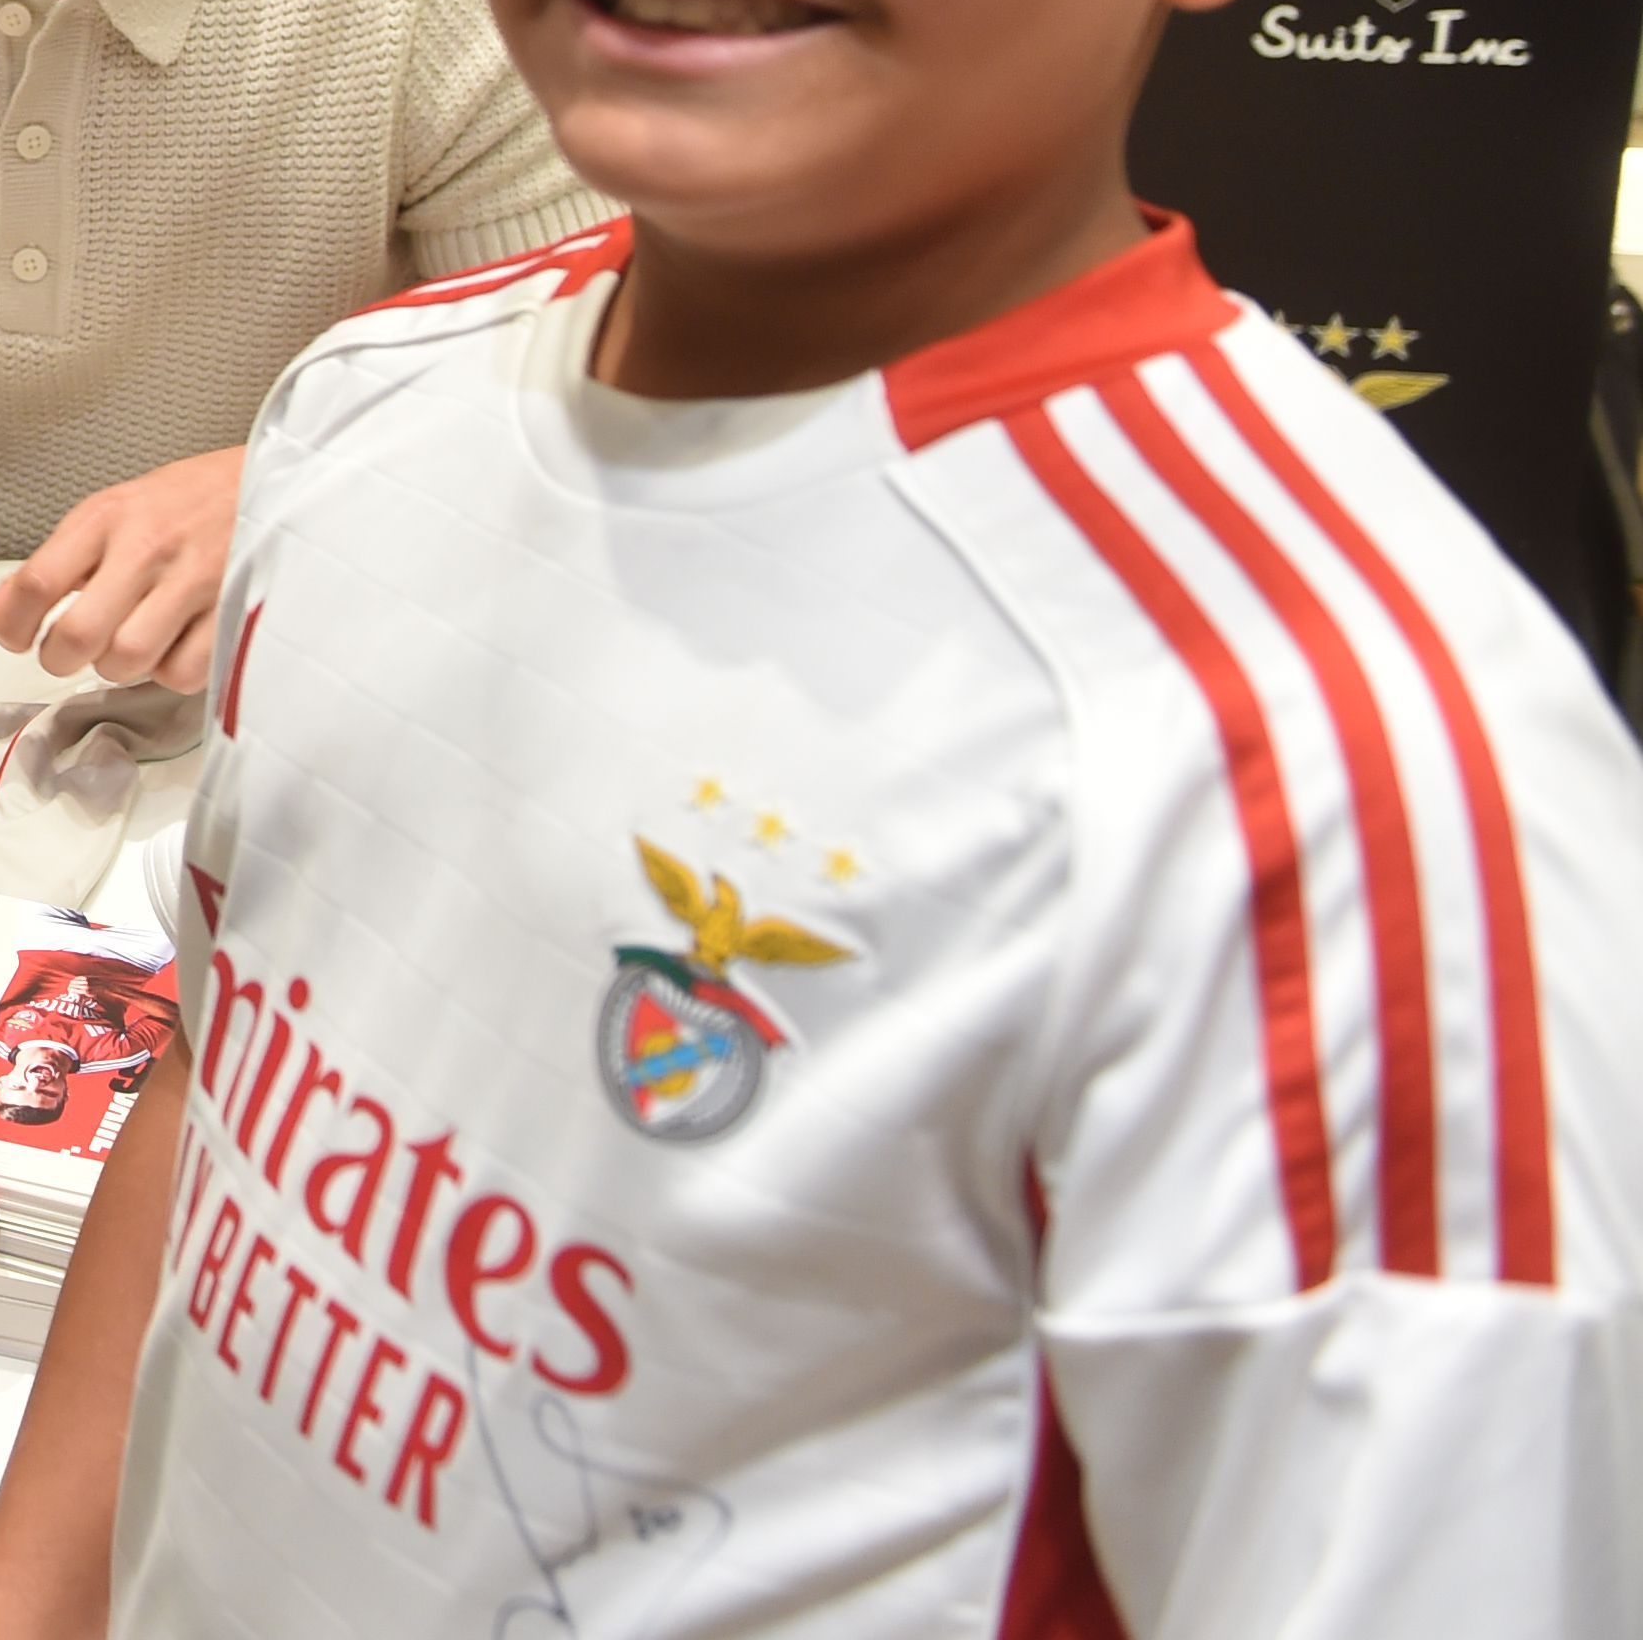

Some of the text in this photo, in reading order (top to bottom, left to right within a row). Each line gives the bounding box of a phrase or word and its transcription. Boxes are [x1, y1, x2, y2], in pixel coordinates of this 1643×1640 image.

[1251, 4, 1533, 67] Suits Inc
[199, 946, 634, 1397] mirates
[187, 1196, 467, 1532] BETTER
